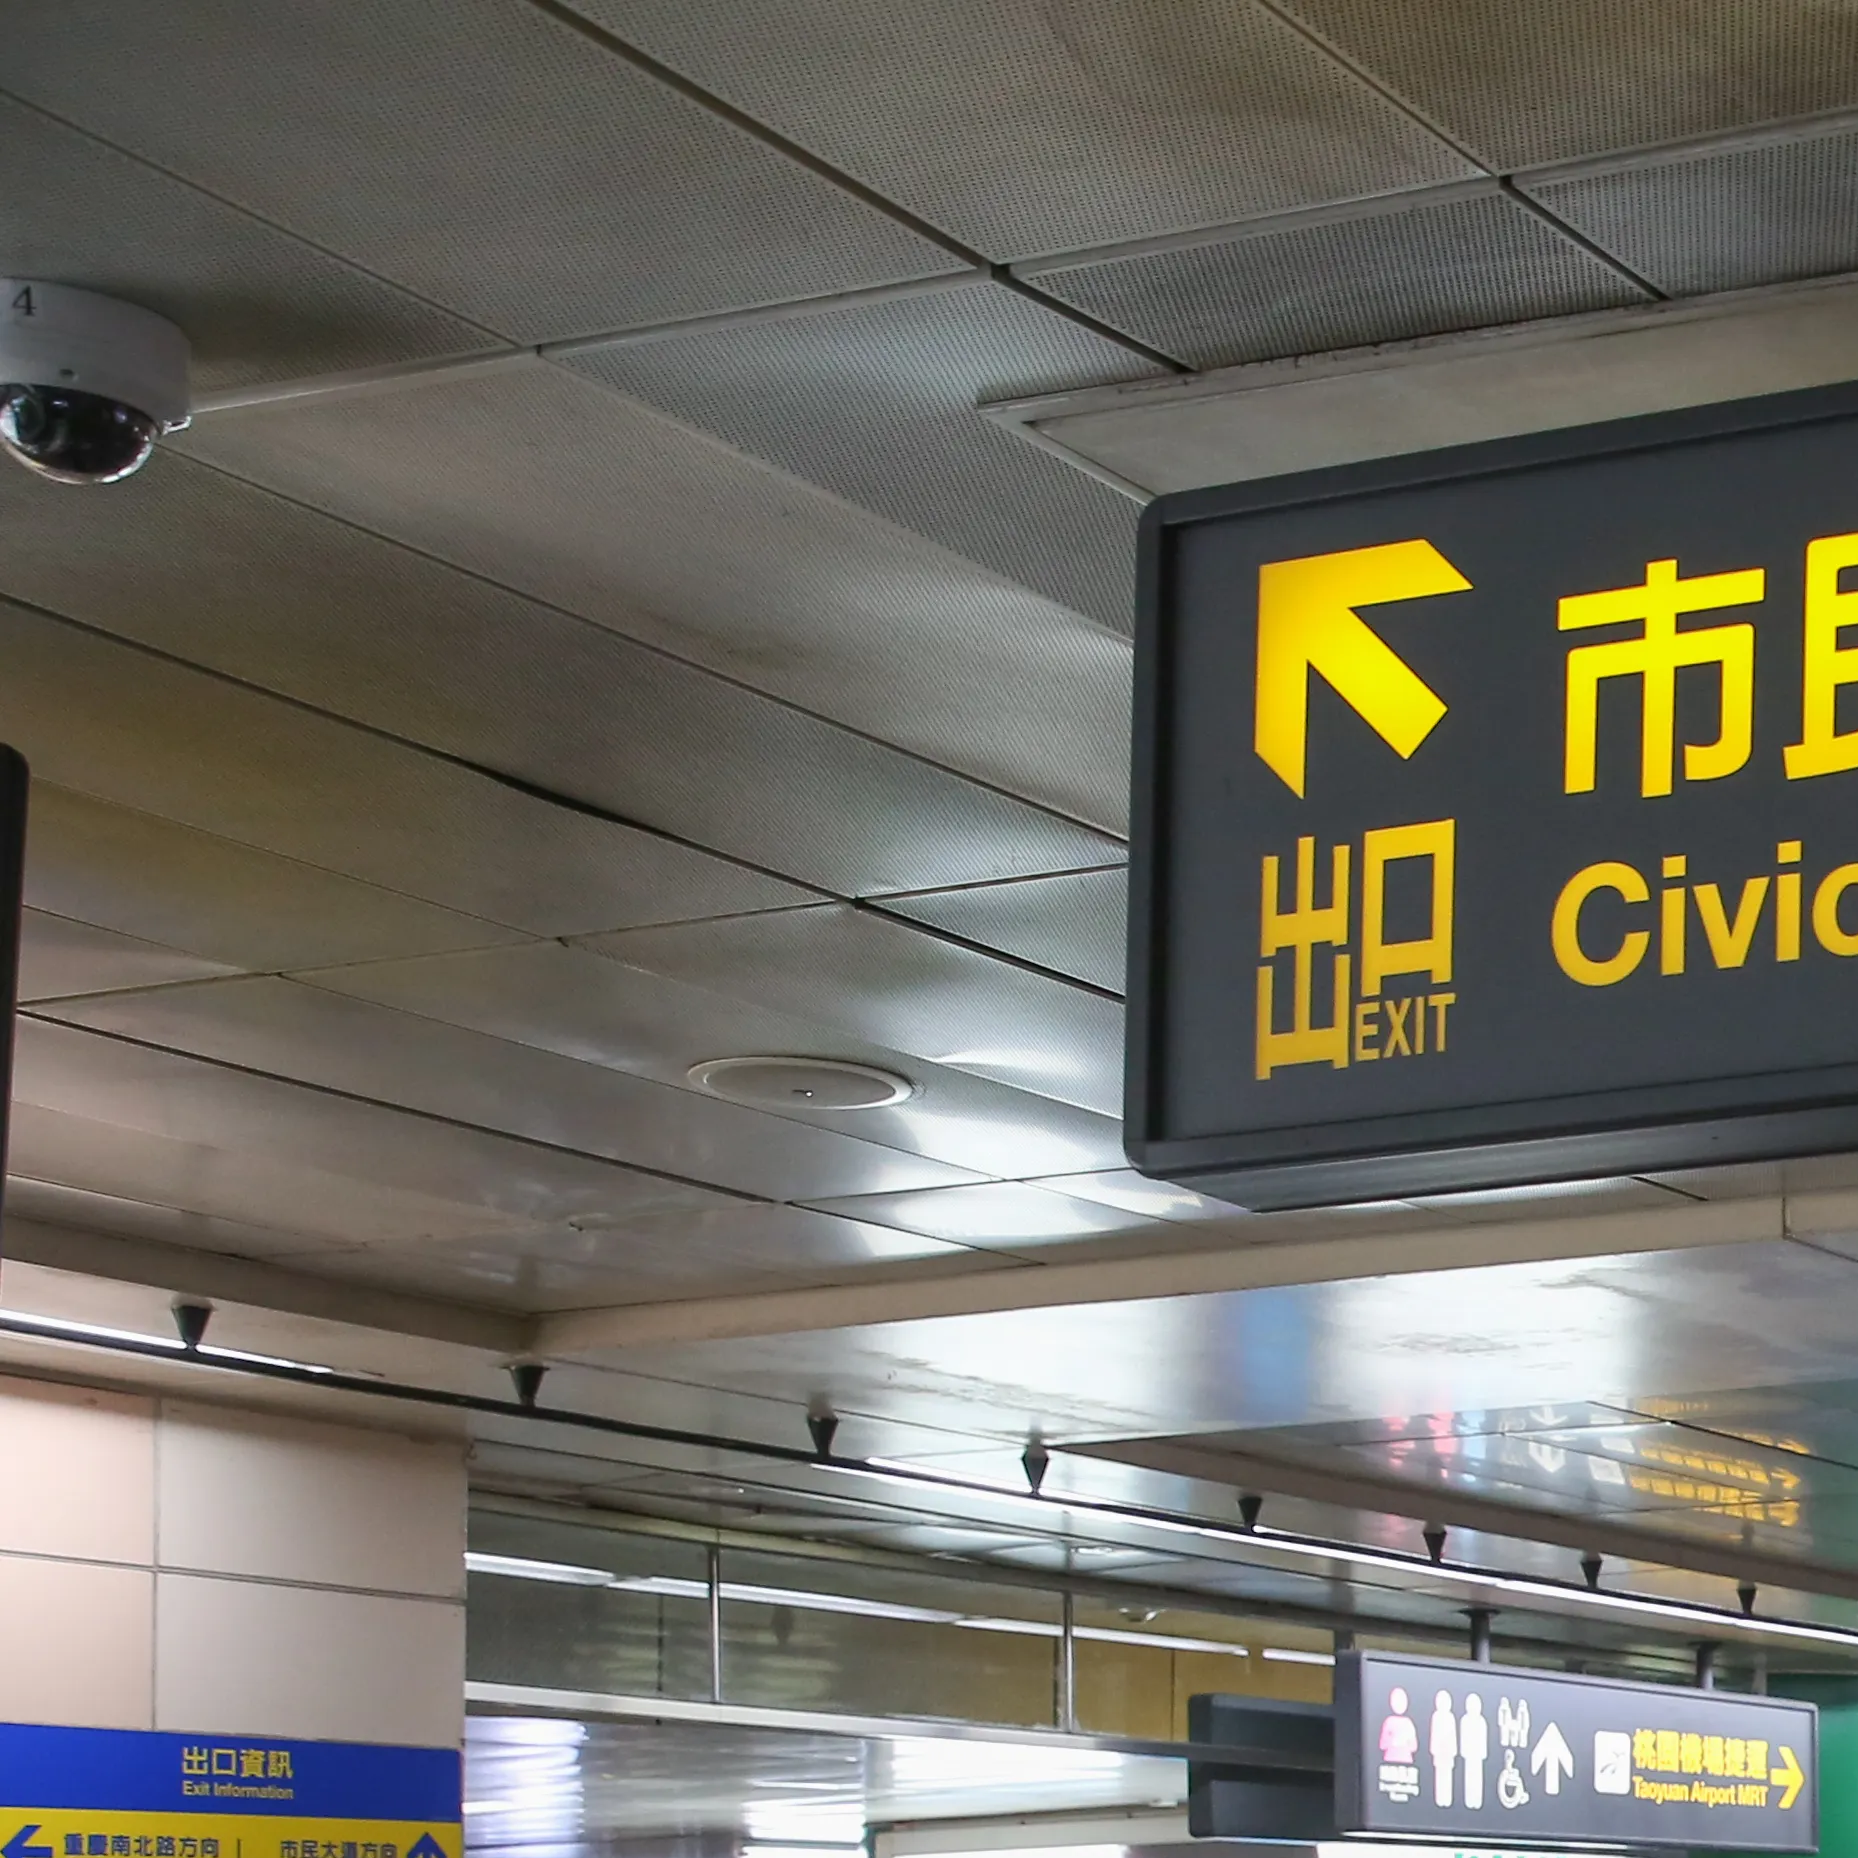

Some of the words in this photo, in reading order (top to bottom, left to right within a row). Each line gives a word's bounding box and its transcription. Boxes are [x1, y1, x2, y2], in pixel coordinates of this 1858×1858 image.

[1256, 818, 1456, 1082] 出口
[1354, 992, 1456, 1062] EXIT
[182, 1747, 294, 1780] 出口資訊
[1633, 1728, 1769, 1781] 桃園機場捷運
[182, 1781, 209, 1796] Exit
[213, 1782, 294, 1800] Information
[1633, 1776, 1690, 1806] Taoyuan
[1691, 1782, 1736, 1808] Airport
[1738, 1785, 1770, 1808] MRT
